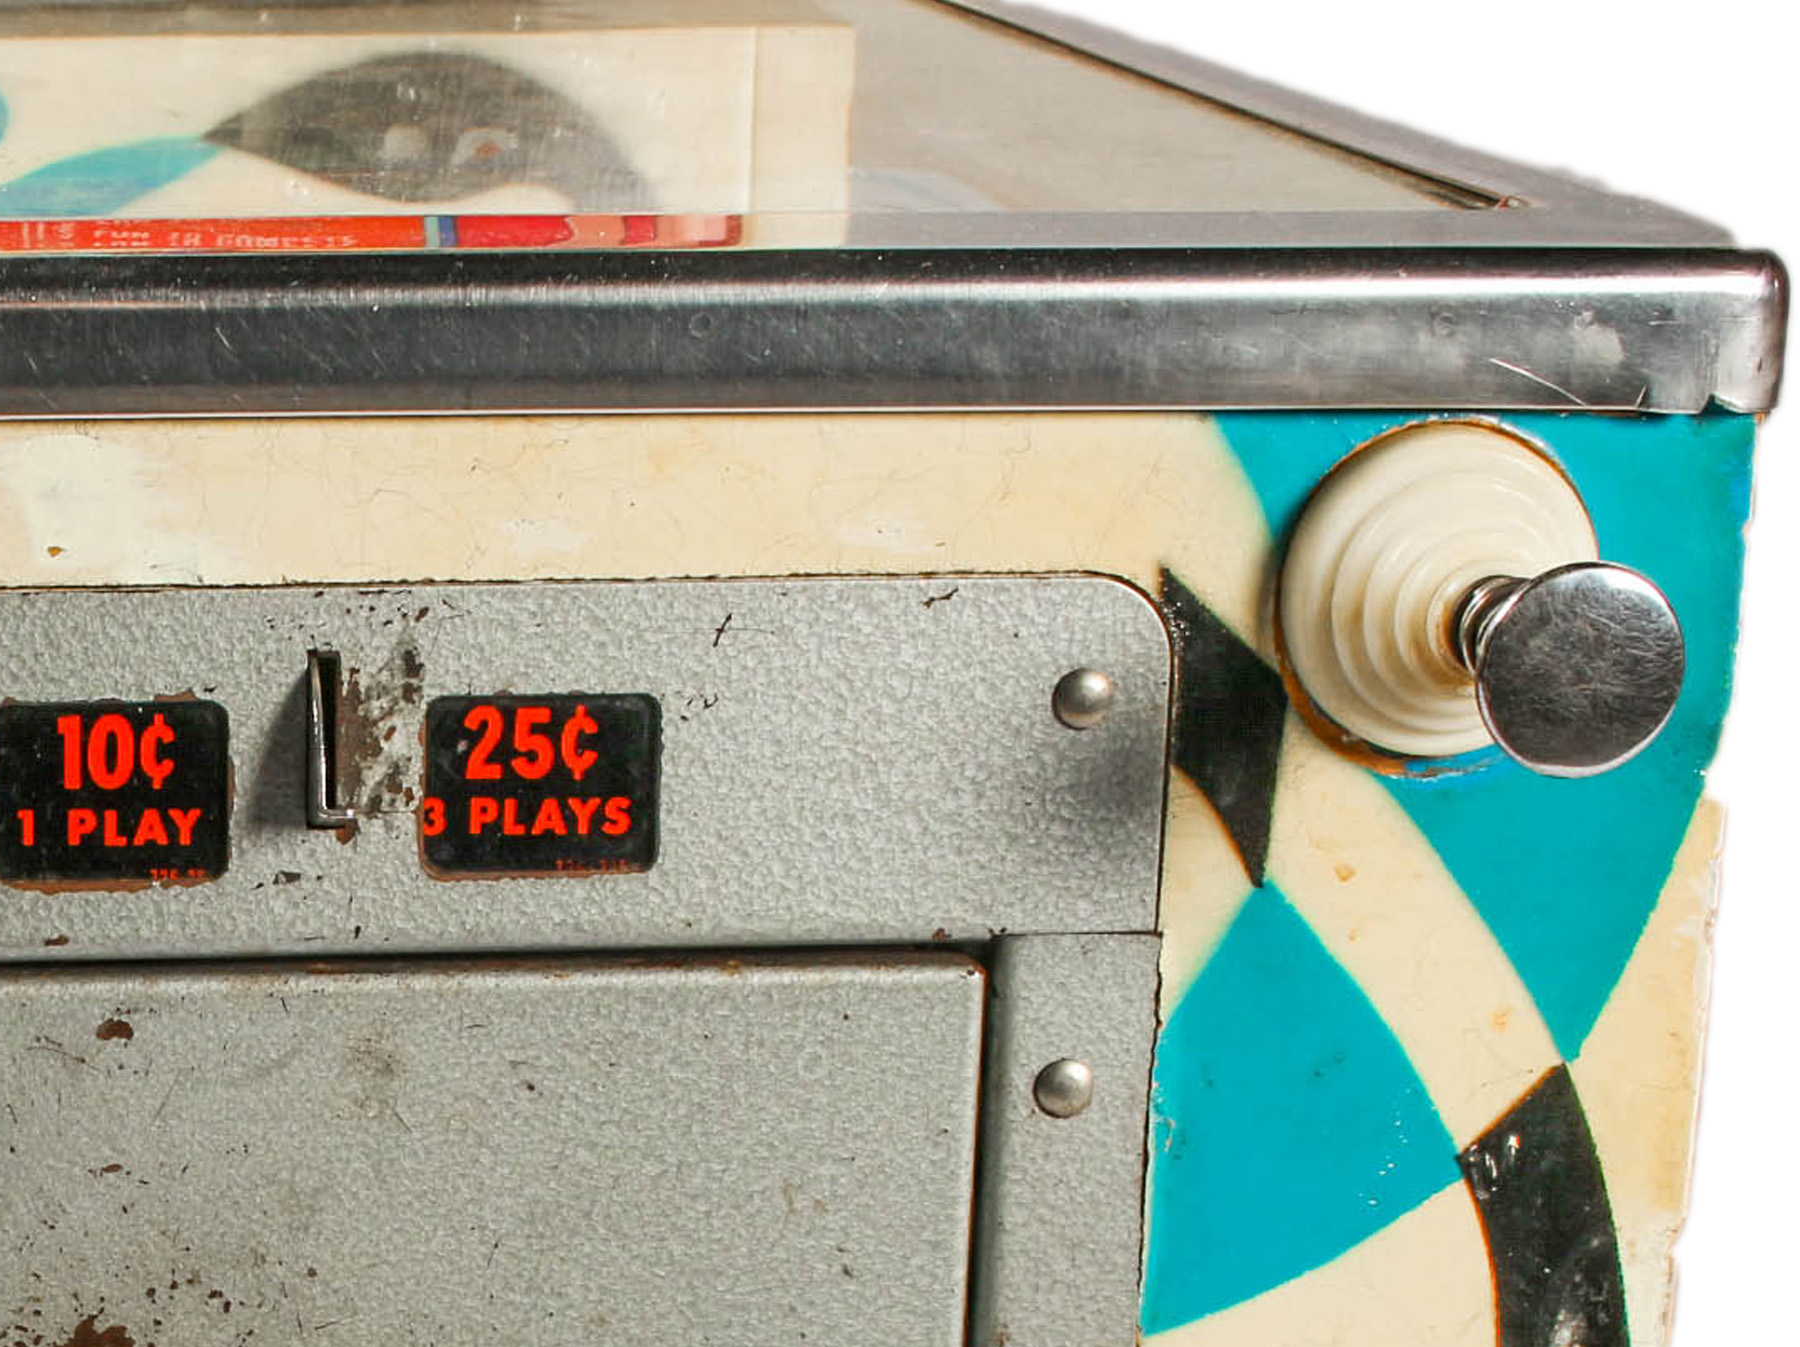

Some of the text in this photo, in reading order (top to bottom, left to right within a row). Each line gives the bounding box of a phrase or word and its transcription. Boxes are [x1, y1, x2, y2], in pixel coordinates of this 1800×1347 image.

[57, 714, 174, 789] 10¢
[464, 705, 598, 780] 25¢
[18, 809, 201, 846] 1 PLAY
[422, 797, 631, 836] 3 PLAYS
